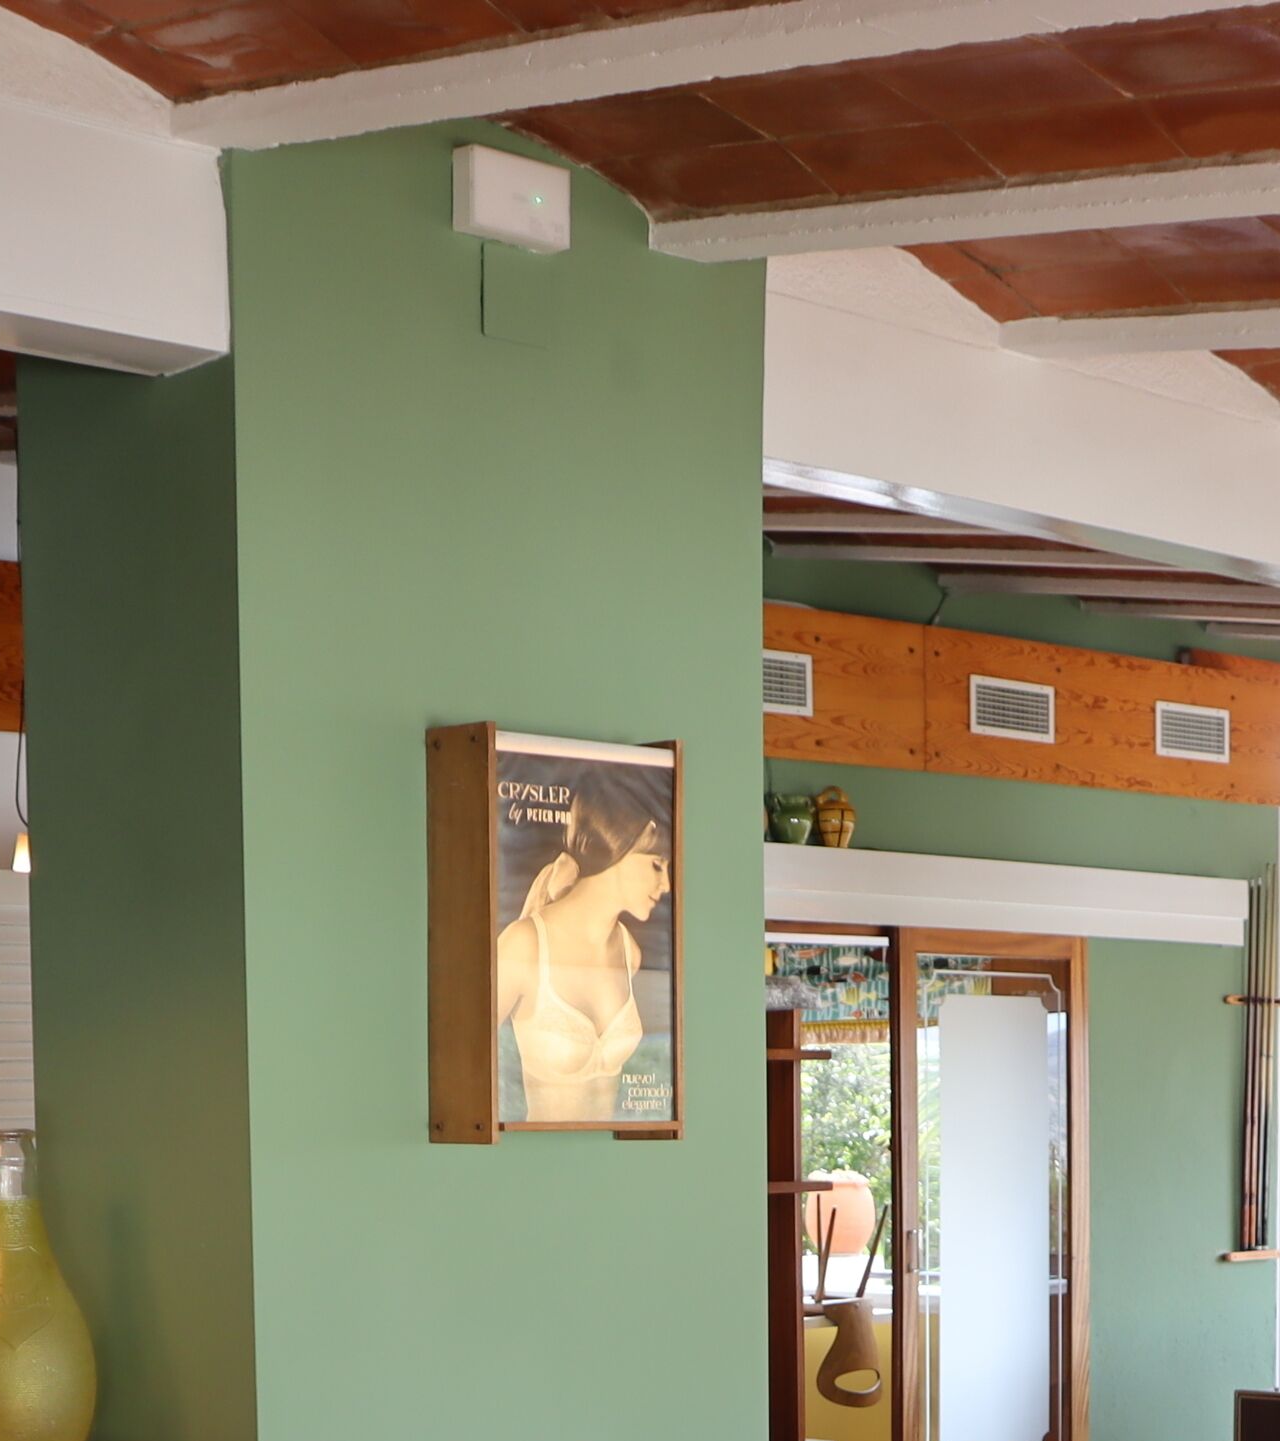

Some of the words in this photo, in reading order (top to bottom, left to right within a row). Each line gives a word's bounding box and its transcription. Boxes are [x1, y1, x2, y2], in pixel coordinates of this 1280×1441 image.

[497, 781, 571, 804] CRYSLER
[508, 802, 523, 825] by
[526, 807, 554, 823] PETER
[554, 810, 572, 825] PAN
[622, 1073, 656, 1084] nuevo!
[622, 1096, 666, 1112] elegante!
